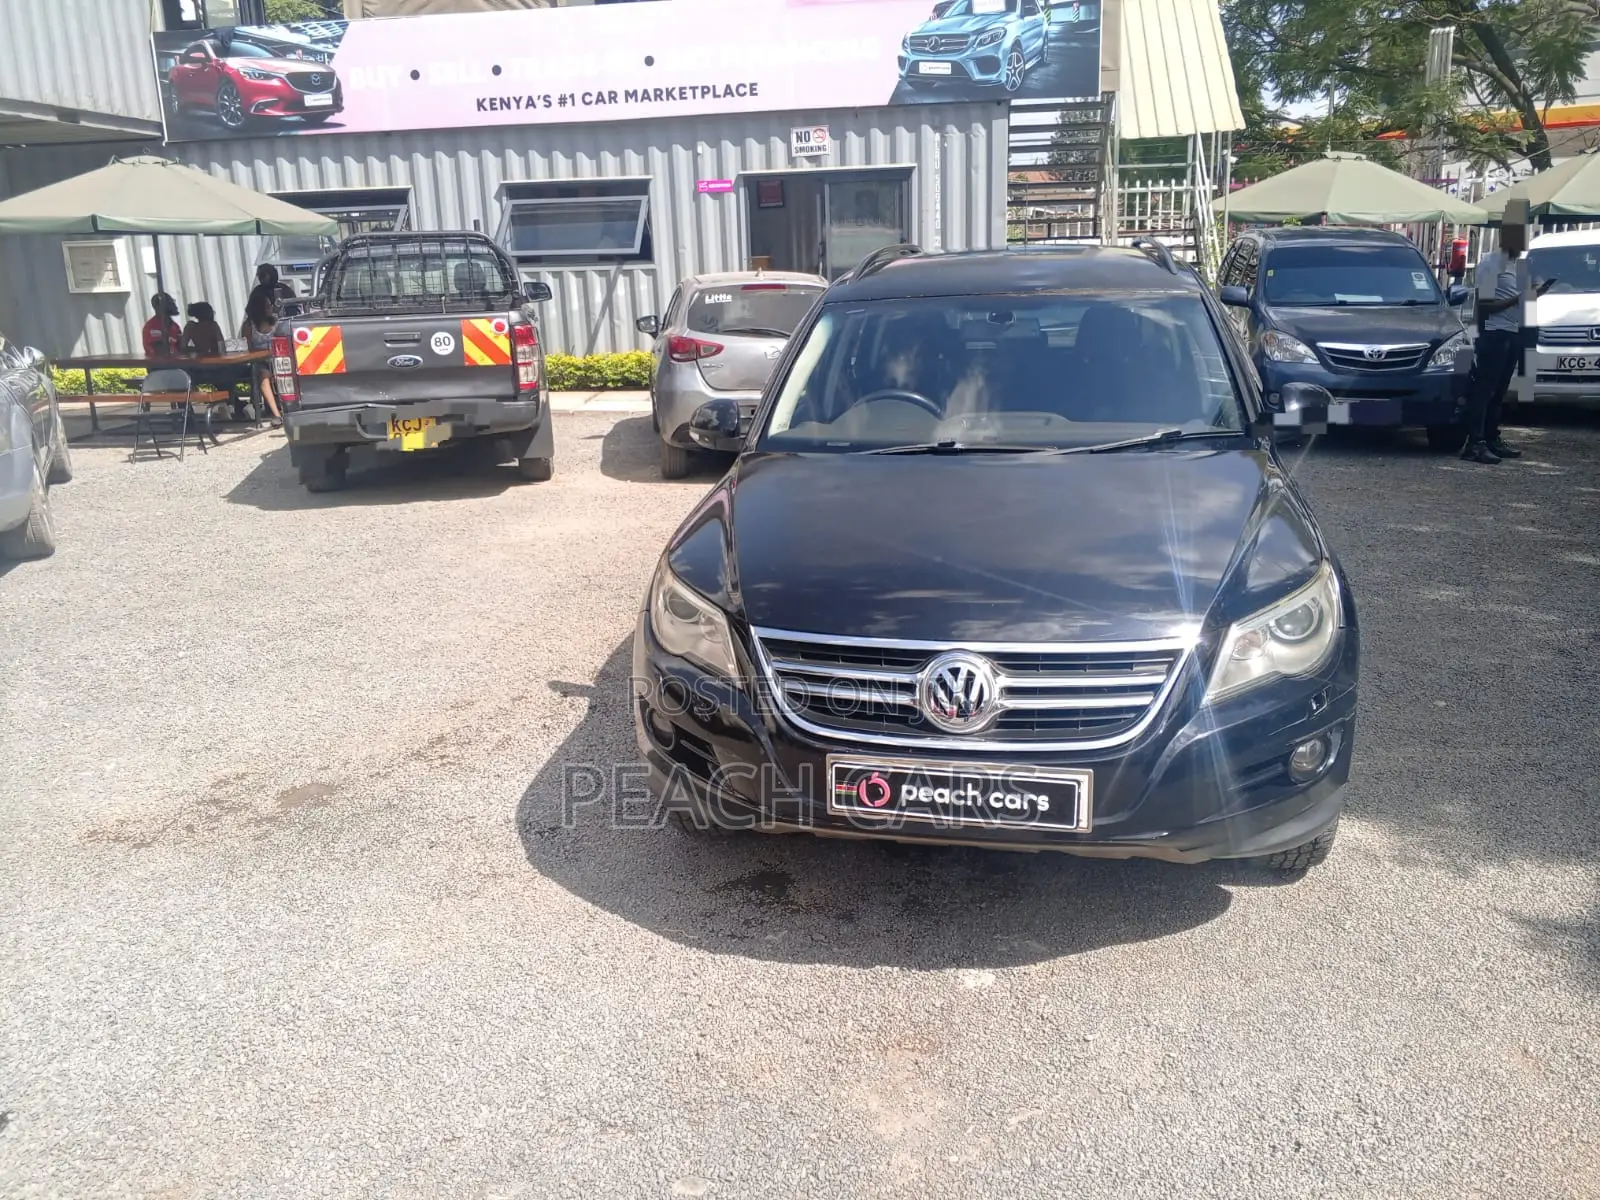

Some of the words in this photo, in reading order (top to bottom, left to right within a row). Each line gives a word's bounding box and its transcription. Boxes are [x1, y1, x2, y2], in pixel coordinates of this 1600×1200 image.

[476, 94, 553, 112] KENYA'S
[558, 92, 577, 108] #1
[581, 90, 619, 106] CAR
[623, 82, 760, 105] MARKETPLACE
[795, 130, 811, 143] NO
[794, 145, 827, 154] SMOKING
[434, 335, 451, 347] 80
[1558, 357, 1586, 369] KCG
[390, 417, 422, 432] KCJ
[901, 783, 982, 807] peach
[989, 791, 1050, 811] cars
